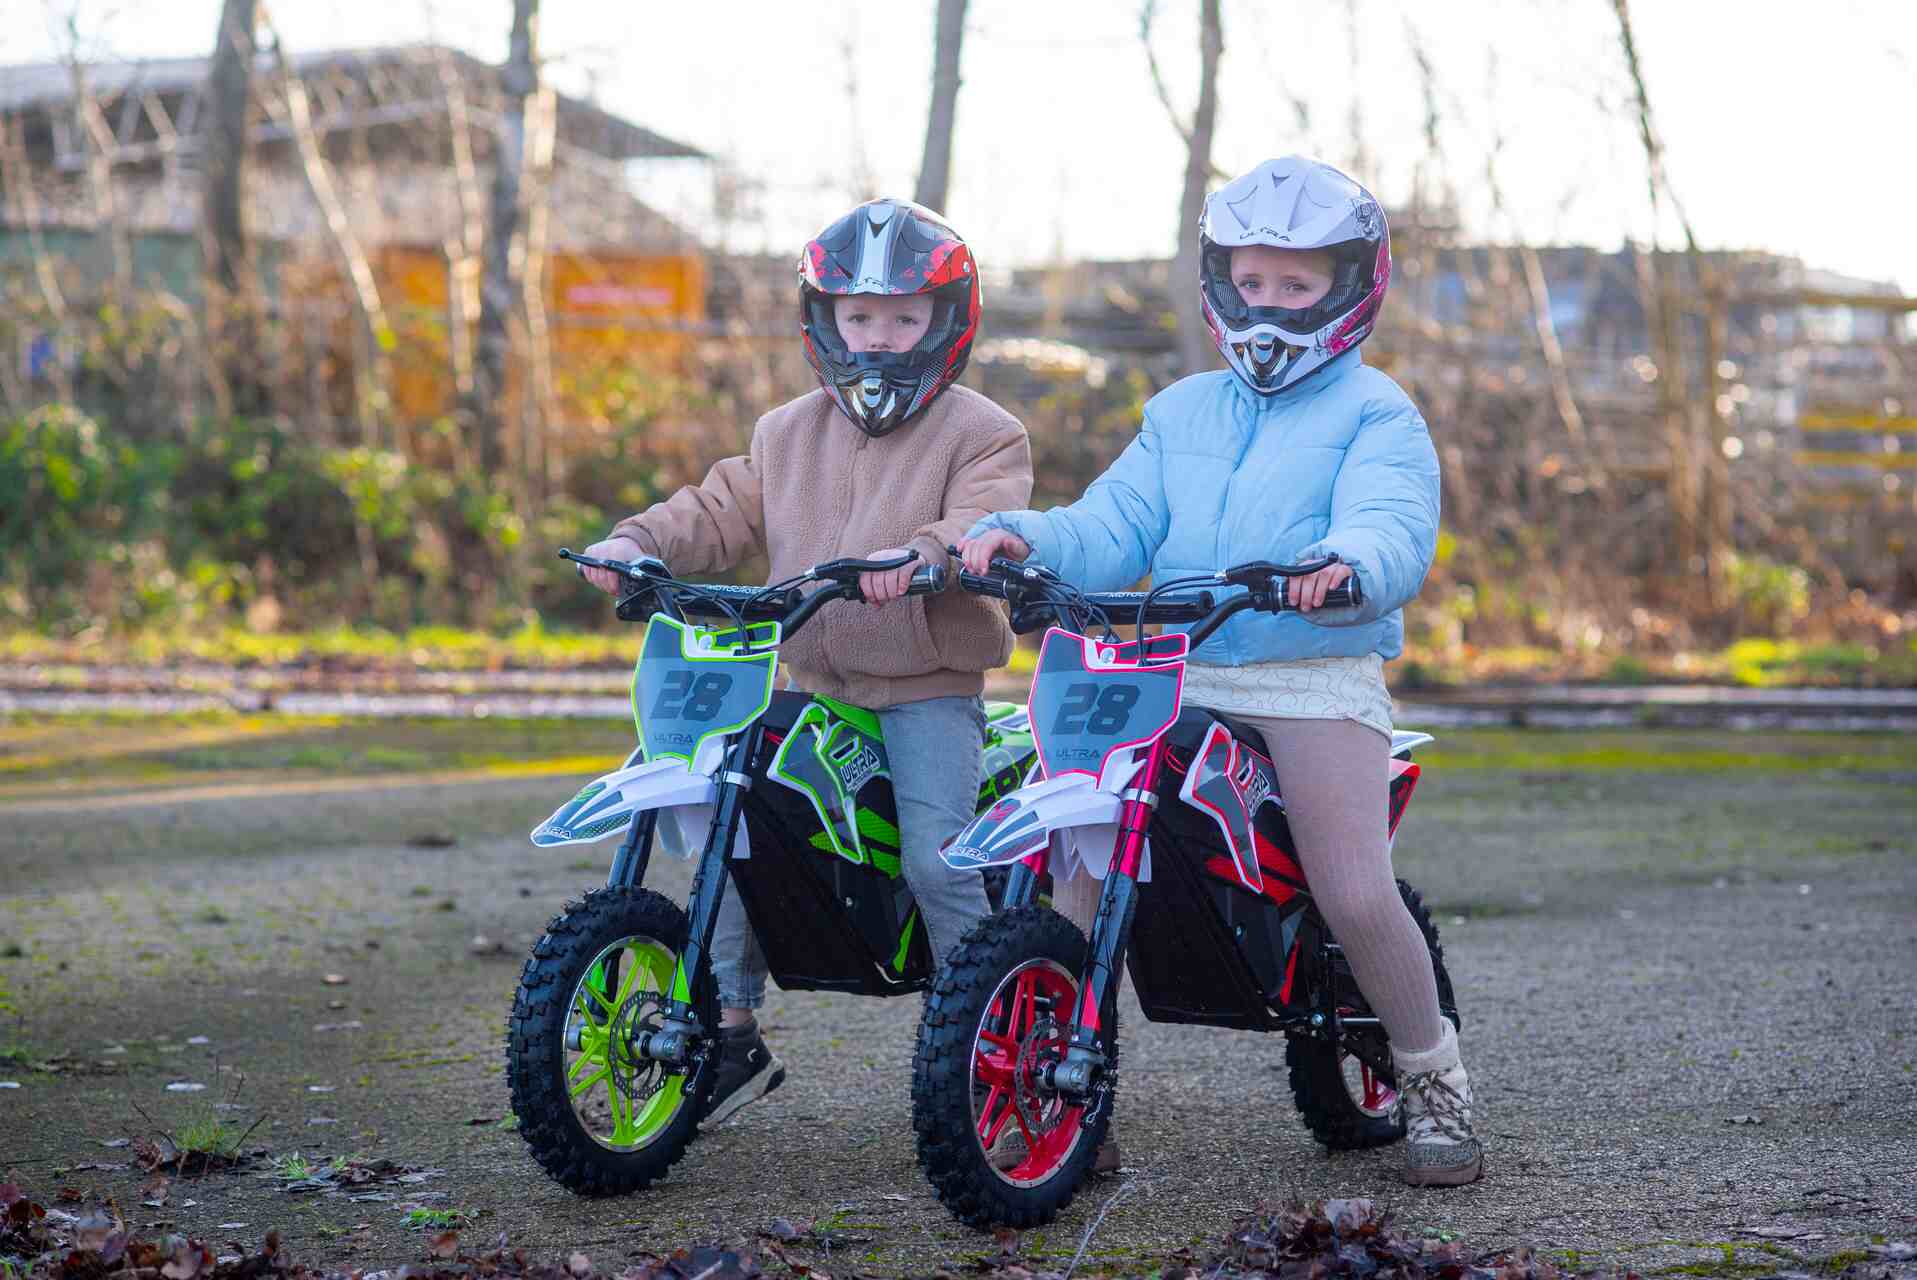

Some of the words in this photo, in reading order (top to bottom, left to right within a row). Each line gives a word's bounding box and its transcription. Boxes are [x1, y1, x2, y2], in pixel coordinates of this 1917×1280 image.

[648, 670, 733, 721] 28
[1050, 683, 1140, 736] 28
[840, 745, 880, 785] ULTRA
[1056, 748, 1101, 760] ULTRA
